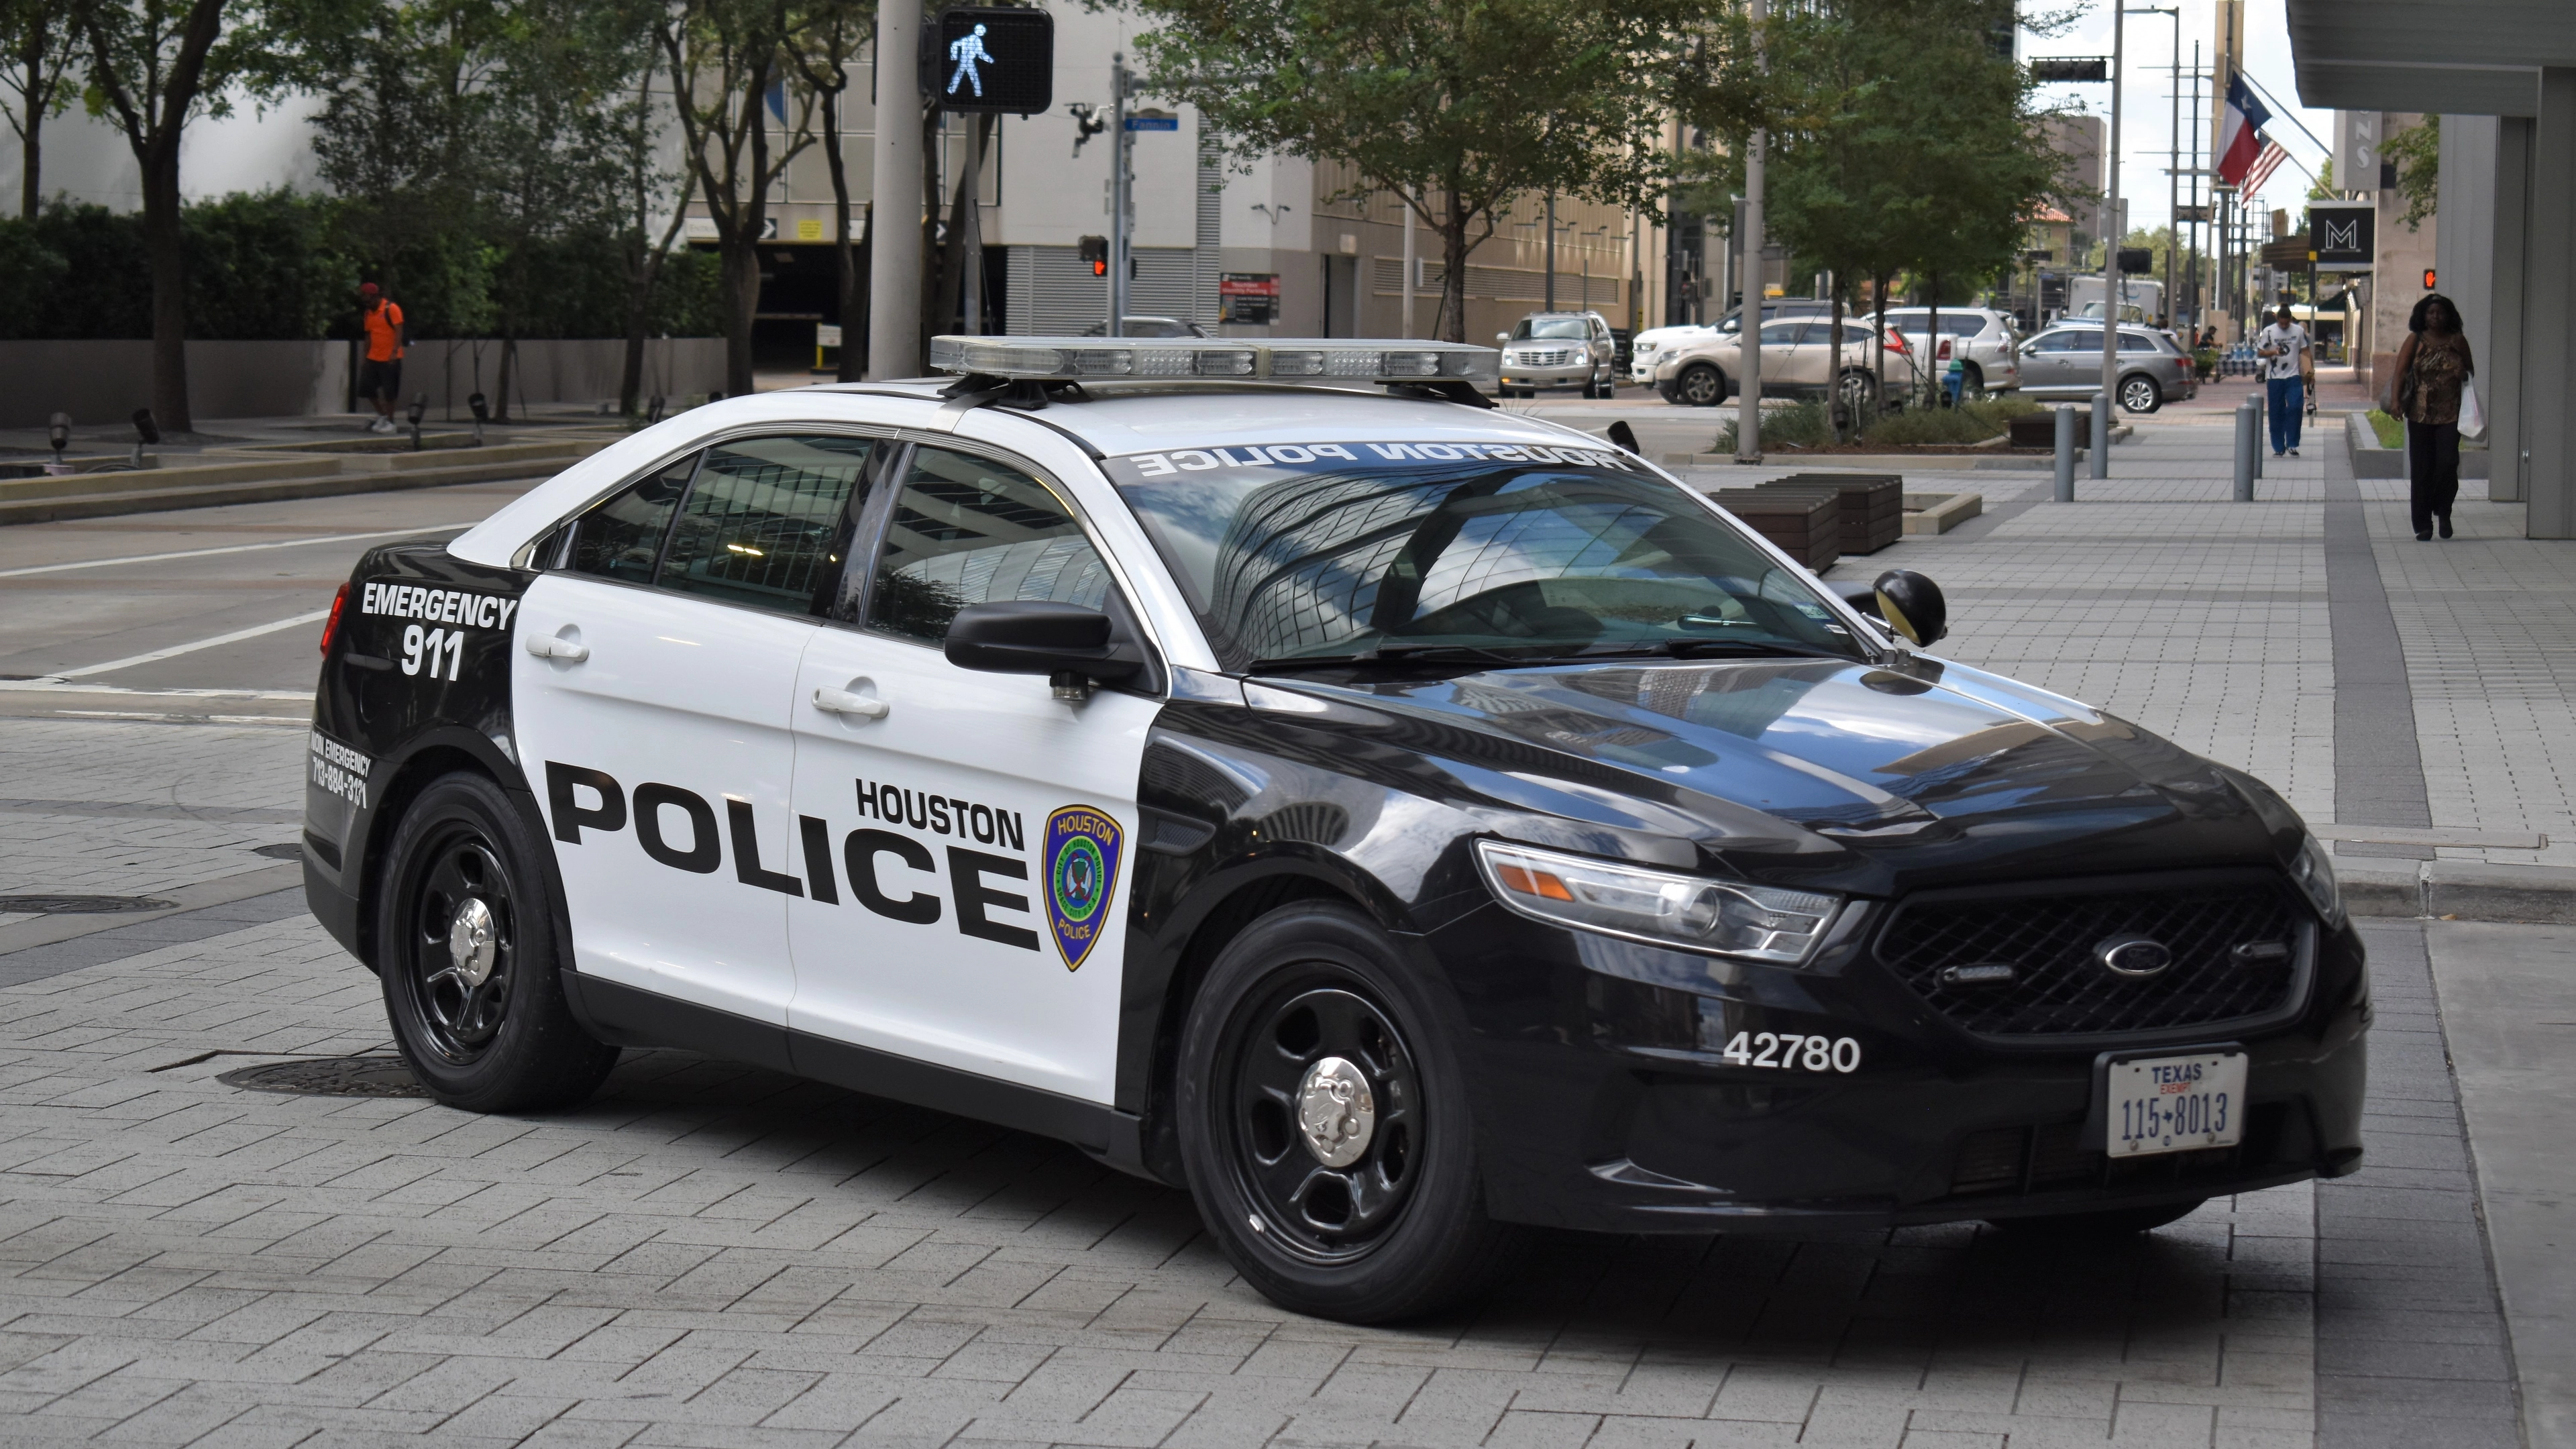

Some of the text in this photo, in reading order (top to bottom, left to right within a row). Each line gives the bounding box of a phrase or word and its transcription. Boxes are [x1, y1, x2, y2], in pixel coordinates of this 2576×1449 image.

[1132, 121, 1170, 129] Fannin
[2326, 219, 2357, 249] M
[362, 582, 518, 631] EMERGENCY
[401, 625, 465, 682] 911
[311, 731, 371, 777] NON EMERGENCY
[313, 756, 367, 809] 713-884-3131
[855, 778, 1025, 852] HOUSTON
[1057, 814, 1115, 846] HOUSTON
[544, 760, 1041, 952] POLICE
[1058, 918, 1091, 939] POLICE
[1723, 1031, 1861, 1073] 42780
[2151, 1063, 2202, 1084] TEXAS
